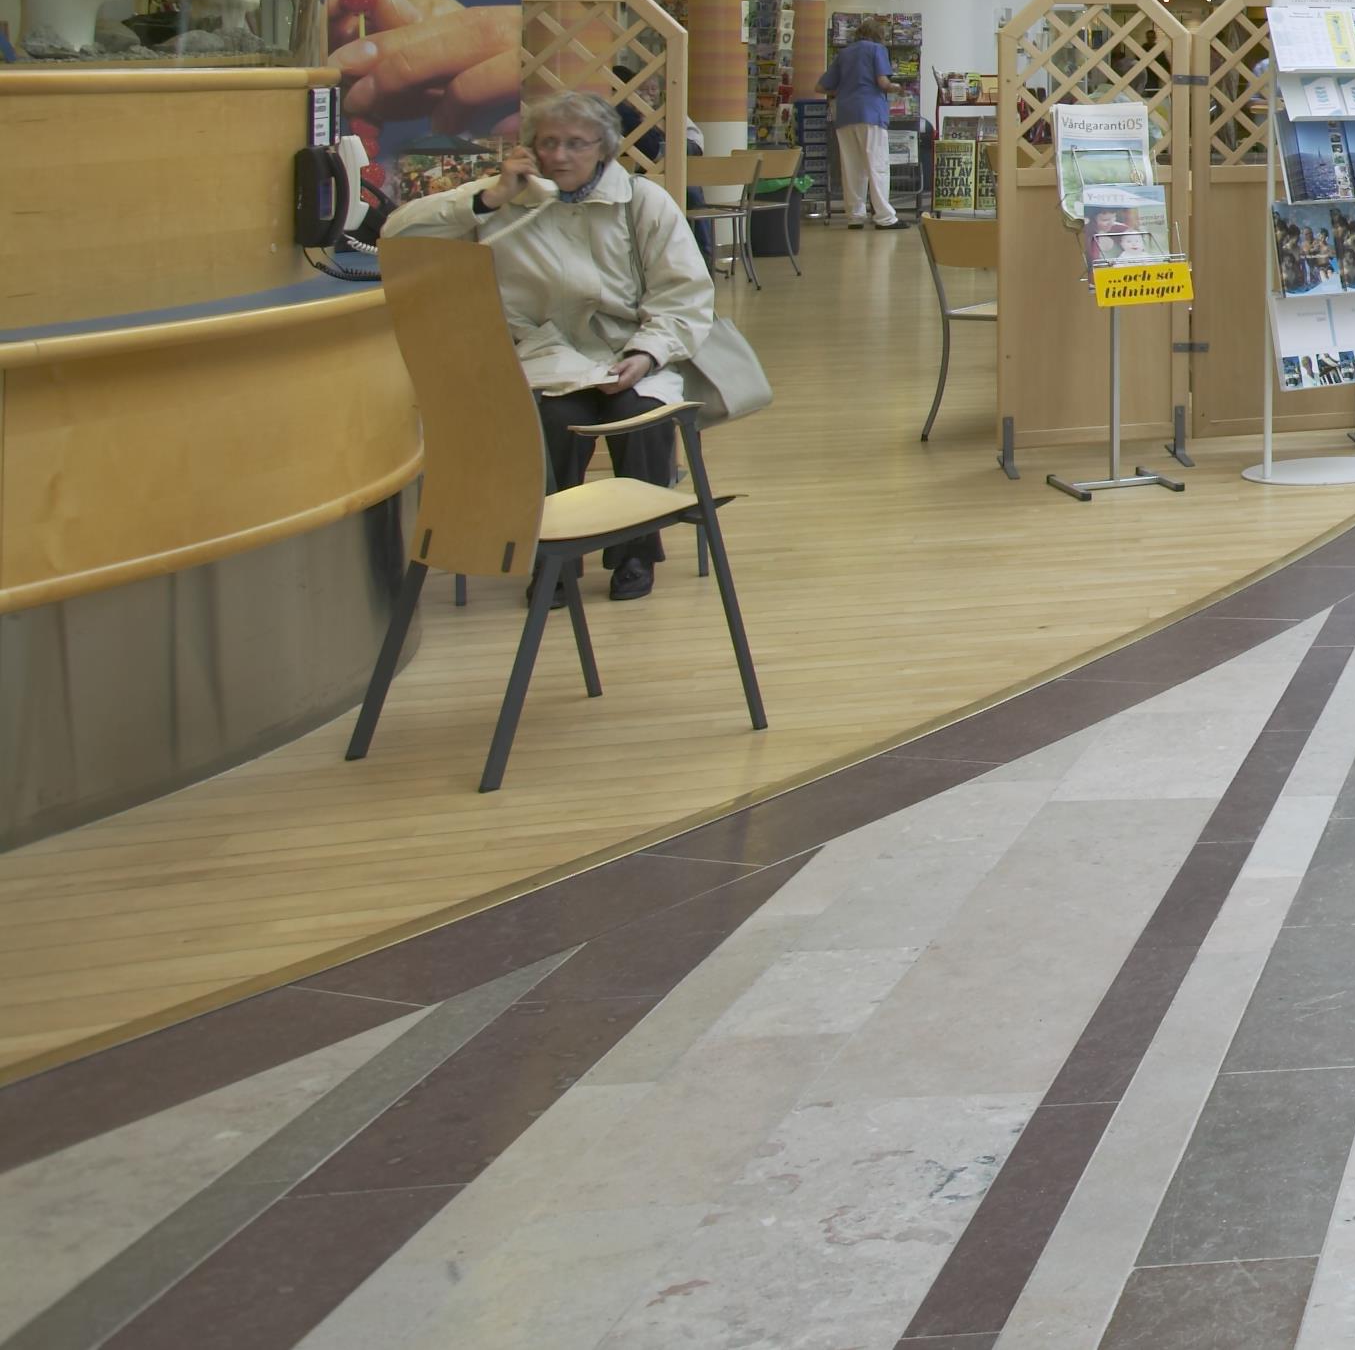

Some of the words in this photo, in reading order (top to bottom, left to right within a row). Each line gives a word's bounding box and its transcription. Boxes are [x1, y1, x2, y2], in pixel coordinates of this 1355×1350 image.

[936, 168, 956, 177] TEST
[959, 168, 972, 177] AV
[935, 178, 972, 187] DIGITAL-
[935, 187, 971, 197] BOXAR
[1108, 270, 1151, 284] ...och
[1156, 269, 1174, 281] så
[1104, 284, 1185, 300] tidningar
